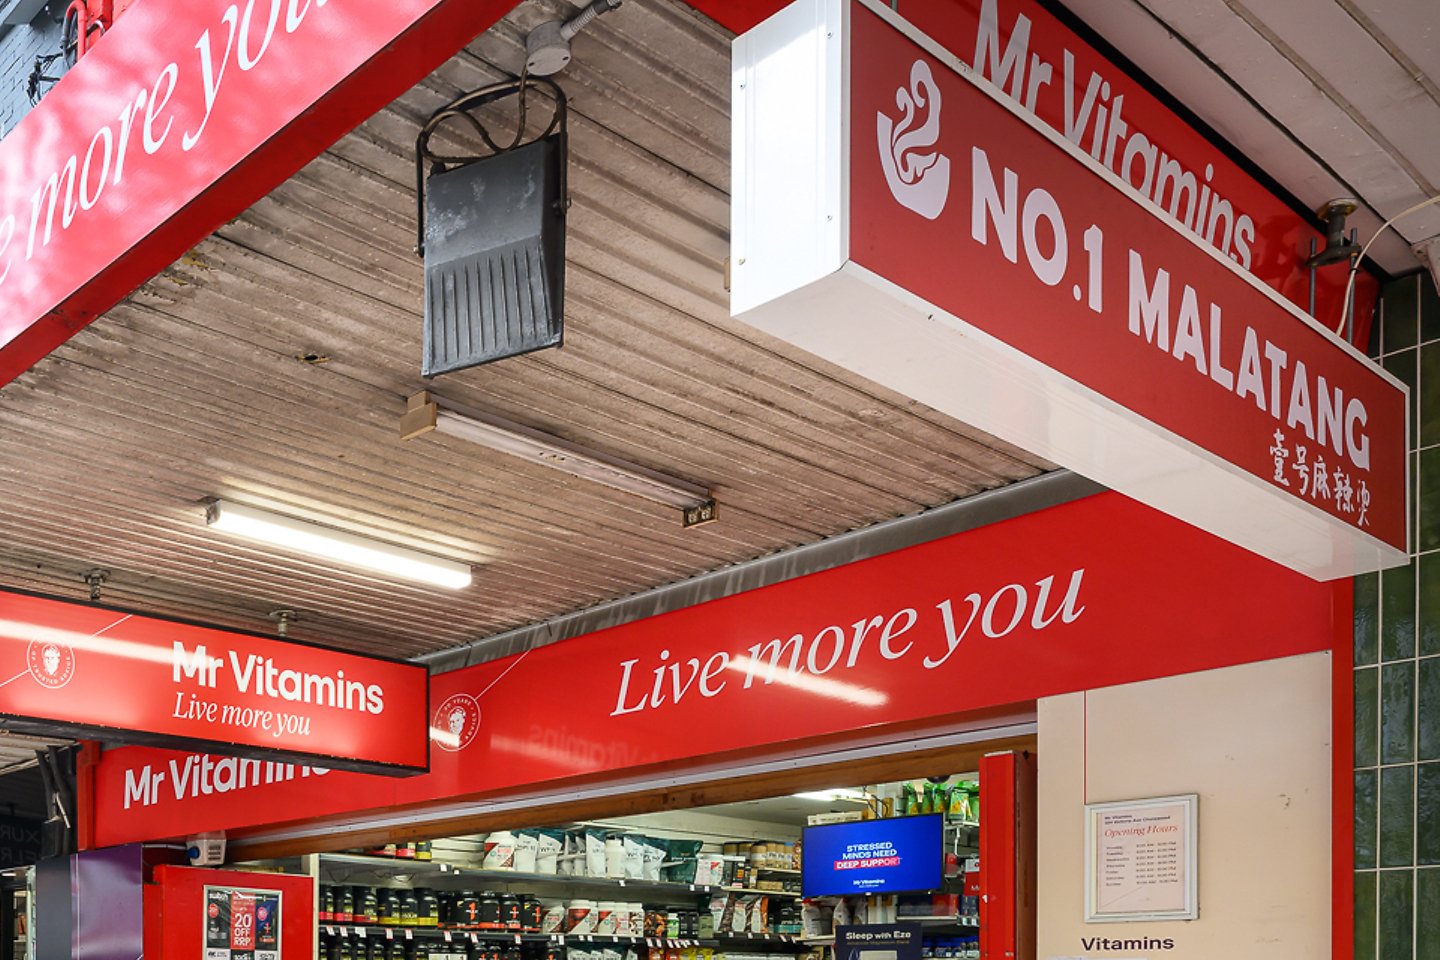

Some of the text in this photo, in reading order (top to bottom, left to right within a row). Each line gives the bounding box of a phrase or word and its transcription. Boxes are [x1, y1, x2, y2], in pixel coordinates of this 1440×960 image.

[973, 0, 1255, 271] Mr Vitamins
[25, 61, 180, 263] more
[971, 145, 1372, 472] NO.1 MALATANG
[610, 568, 1087, 717] Live more you
[171, 640, 384, 716] Mr Vitamins
[172, 692, 312, 738] Live more you
[123, 765, 164, 809] Mr
[1104, 825, 1178, 839] Opening Hours
[846, 841, 893, 852] STRESSED
[842, 849, 898, 860] MINDS NEED
[836, 860, 860, 869] DEEP
[234, 912, 253, 928] 20
[233, 927, 251, 938] OFF
[845, 931, 874, 941] Sleep
[233, 937, 251, 947] RRP
[1081, 936, 1175, 951] Vitamins
